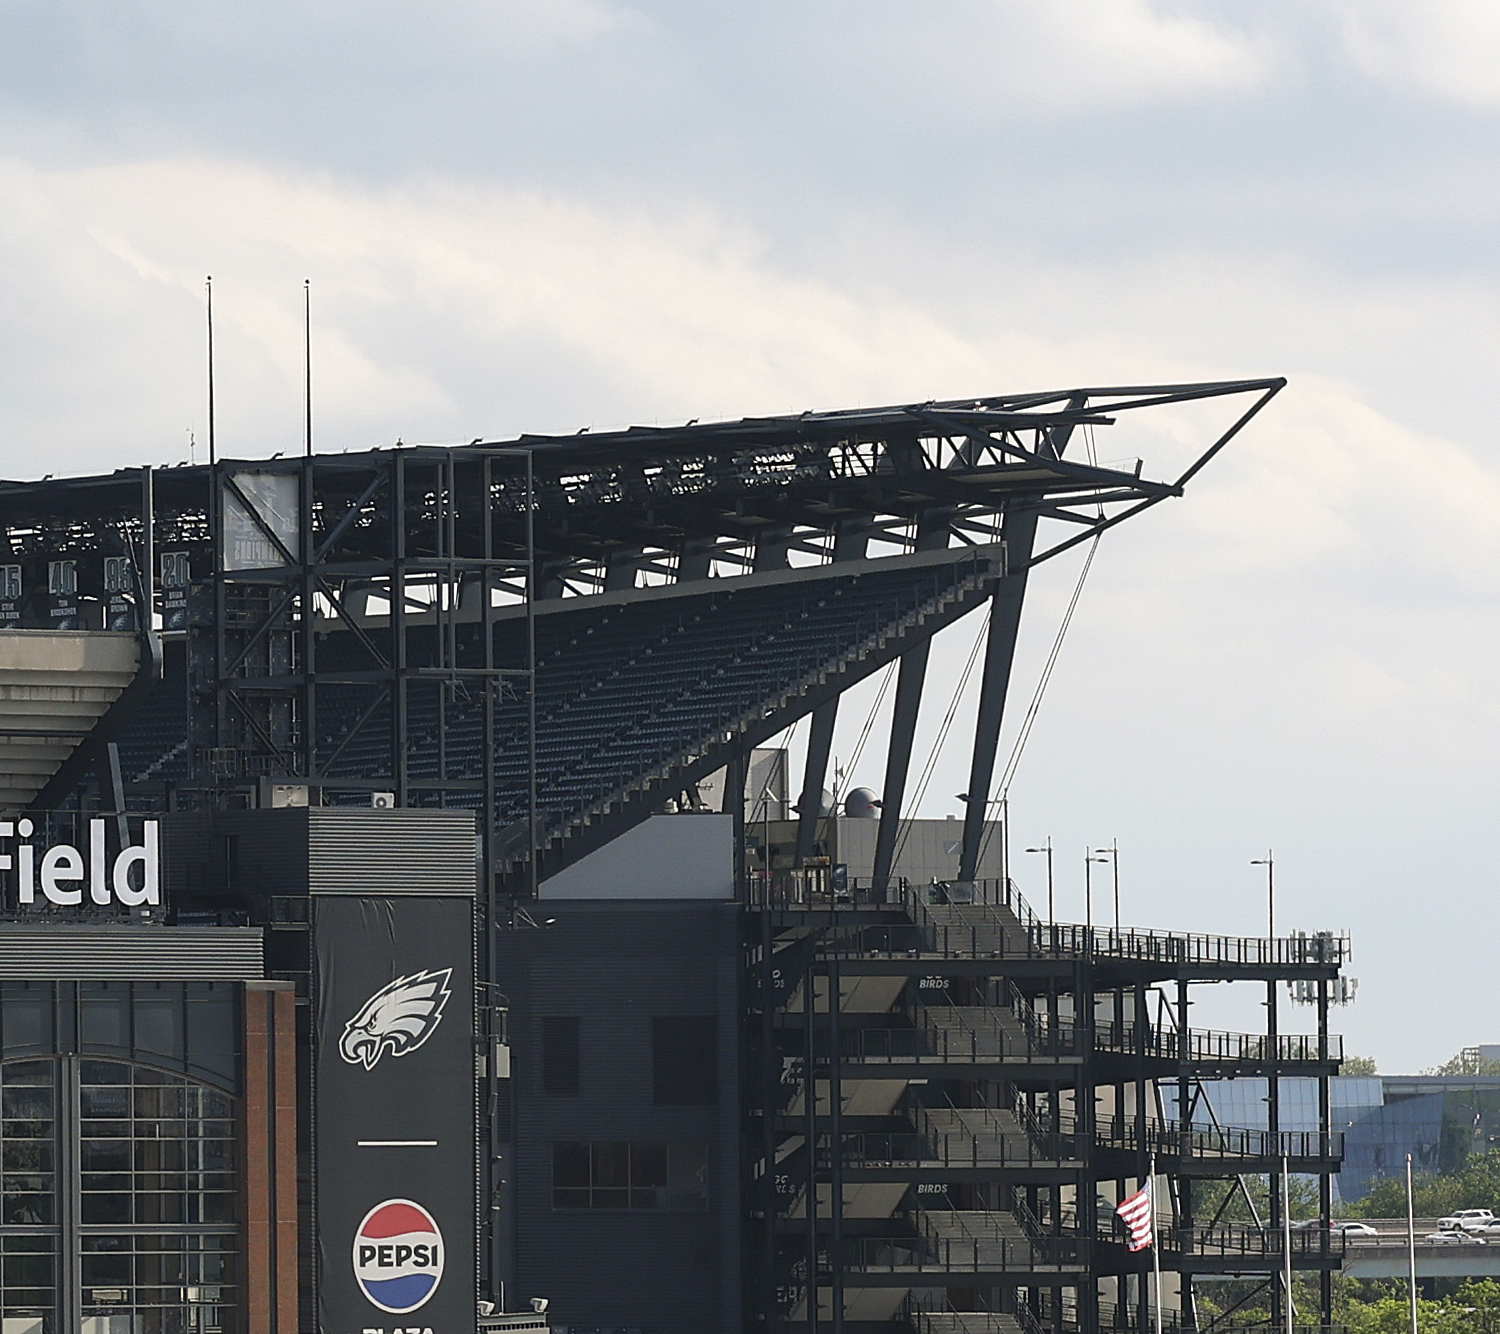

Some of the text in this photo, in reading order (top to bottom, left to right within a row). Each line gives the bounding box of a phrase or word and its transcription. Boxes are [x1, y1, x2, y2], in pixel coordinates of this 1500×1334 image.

[920, 979, 950, 989] BIRDS
[918, 1184, 949, 1193] BIRDS
[360, 1245, 438, 1268] PEPSI
